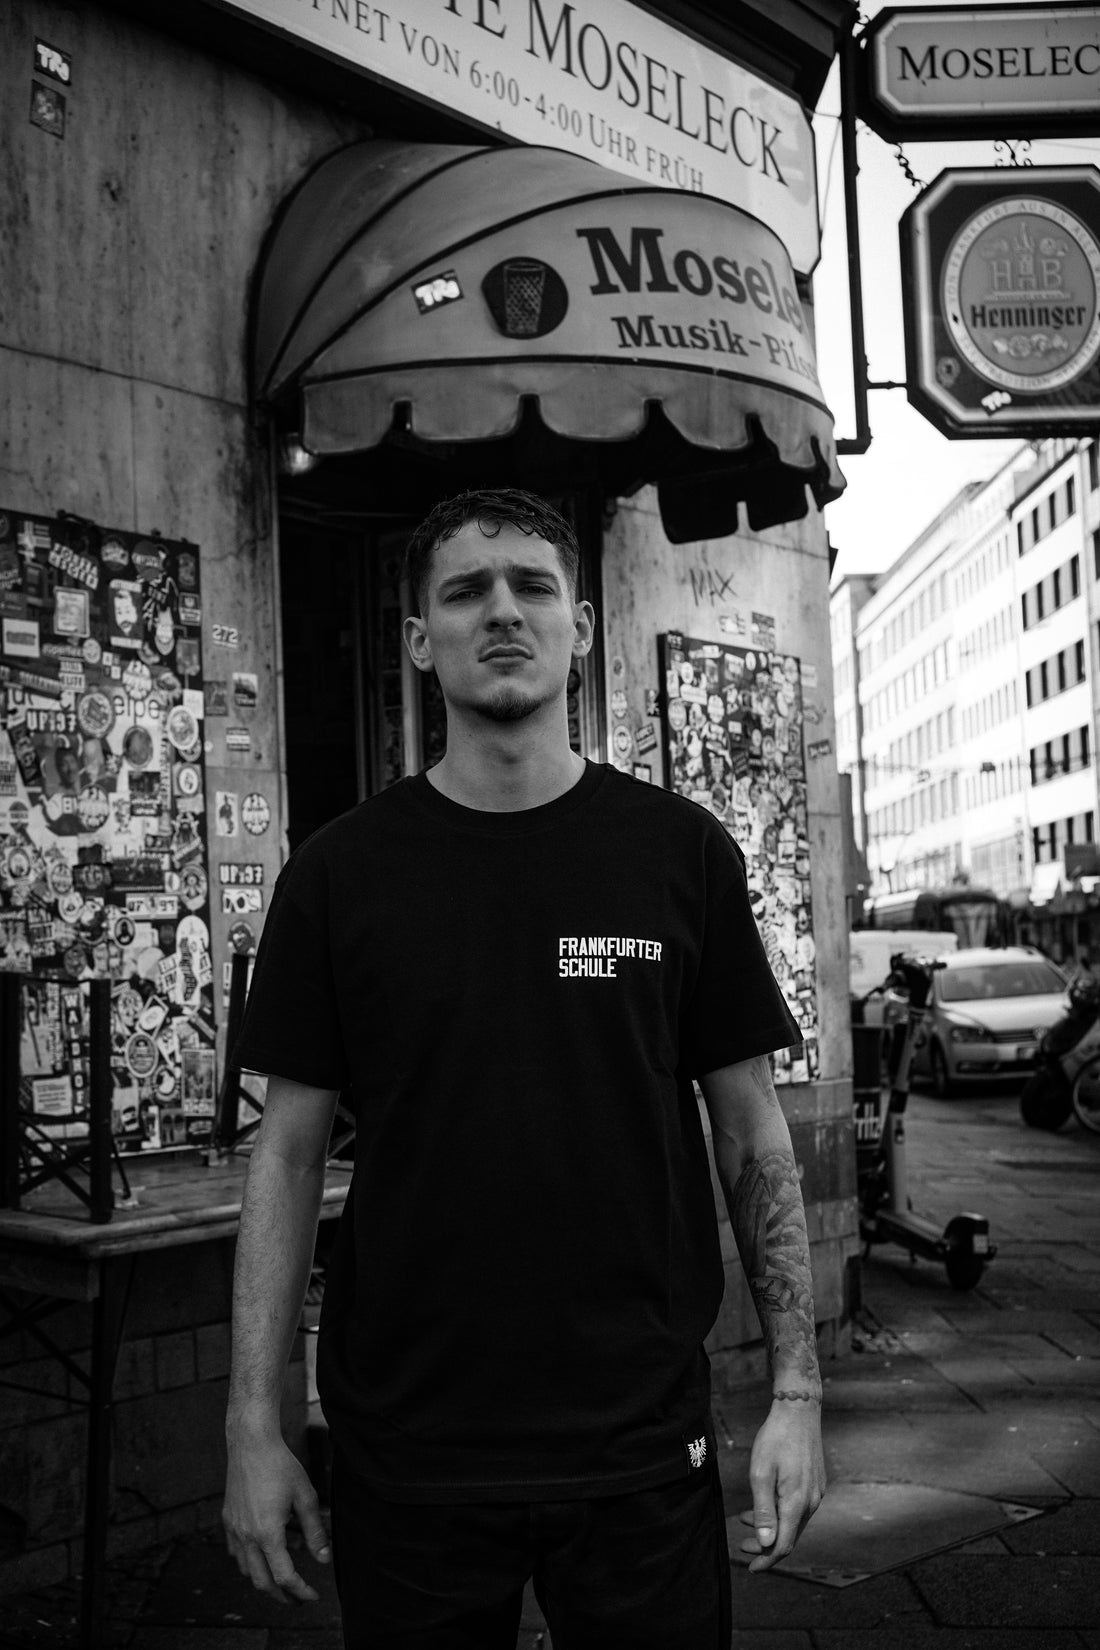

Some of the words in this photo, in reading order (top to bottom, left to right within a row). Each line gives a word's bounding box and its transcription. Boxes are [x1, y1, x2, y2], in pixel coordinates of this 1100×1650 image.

[524, 0, 789, 187] MOSELECK
[400, 21, 460, 77] VON
[589, 113, 640, 166] UHR
[646, 147, 704, 193] FRÜH
[970, 304, 1087, 330] Henninger
[559, 937, 662, 961] FRANKFURTER
[559, 958, 617, 977] SCHULE
